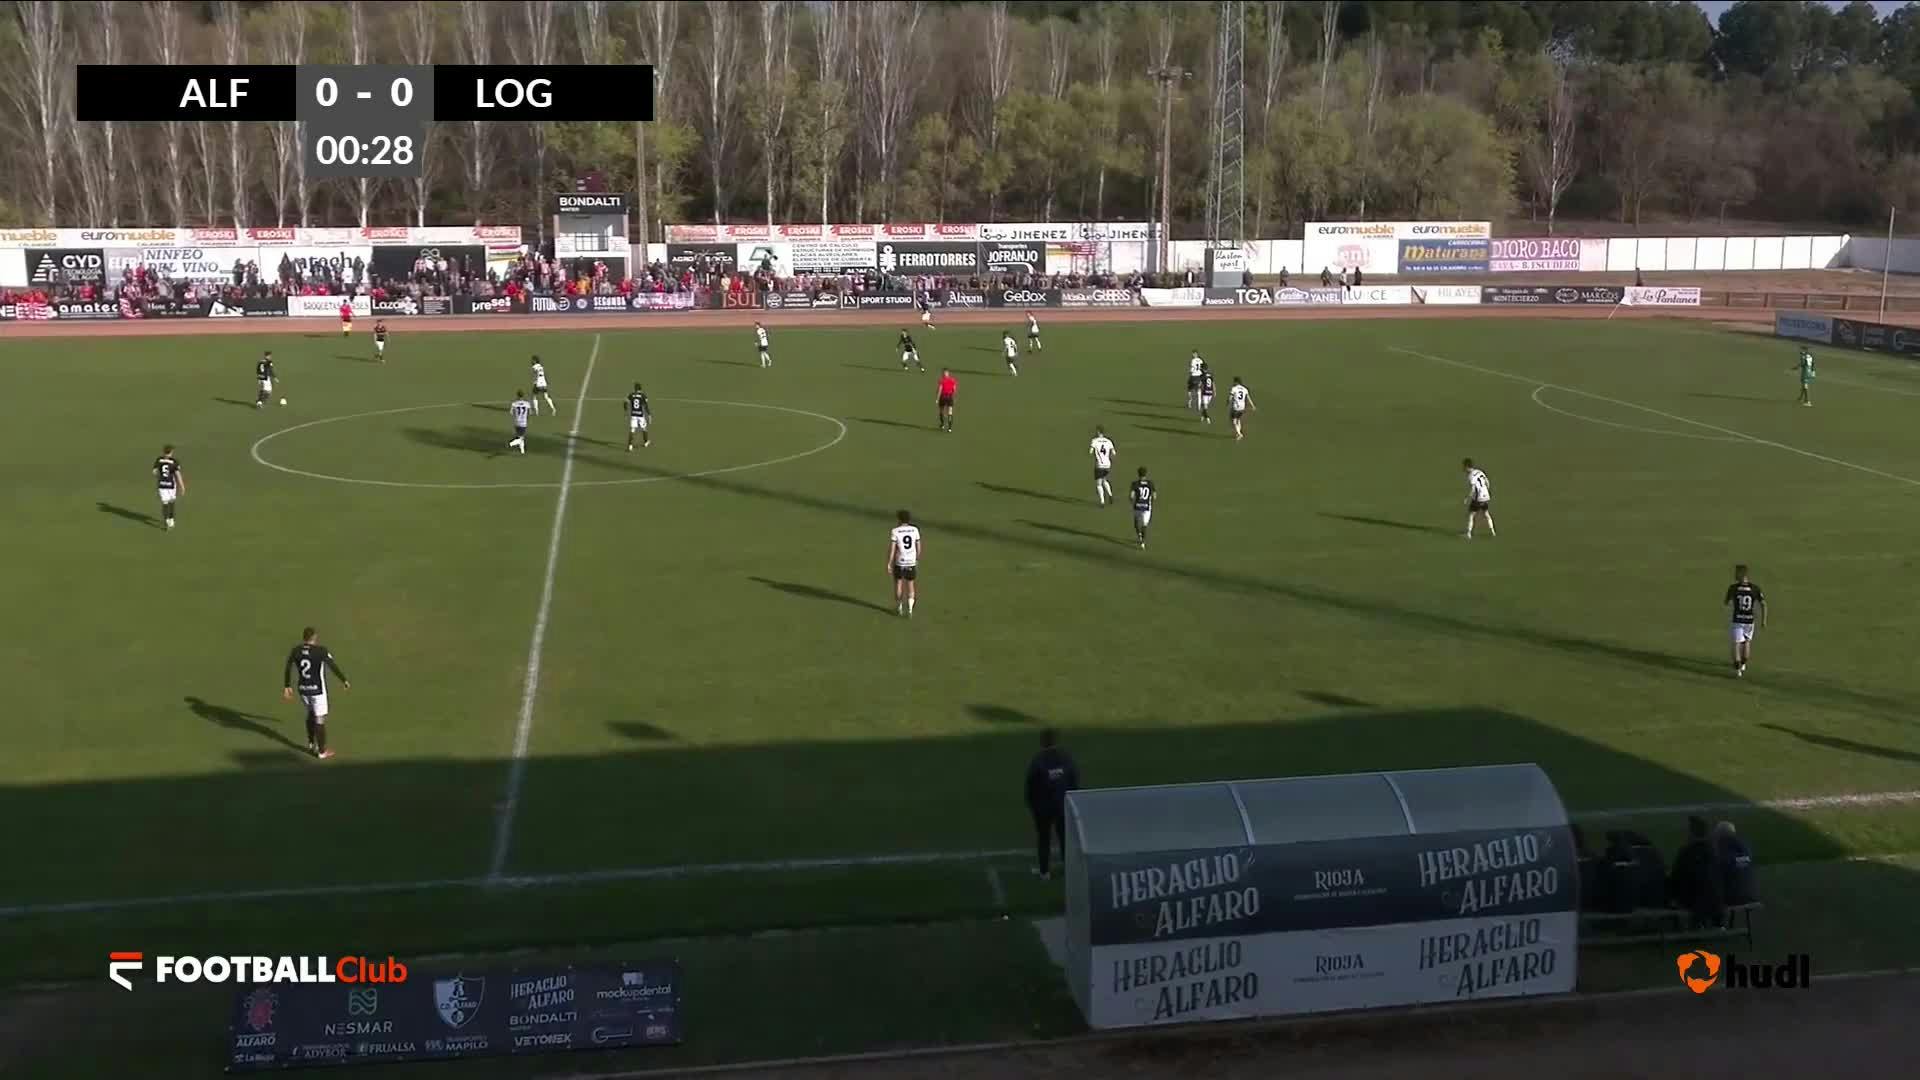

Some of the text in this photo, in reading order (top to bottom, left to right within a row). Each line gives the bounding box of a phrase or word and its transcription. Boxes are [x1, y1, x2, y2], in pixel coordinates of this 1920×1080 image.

[560, 197, 620, 206] BONDALTI
[81, 230, 176, 240] euromueble
[257, 230, 292, 238] EROSKI
[735, 227, 768, 235] EROSKI
[788, 226, 821, 235] EROSKI
[840, 226, 871, 235] EROSKI
[891, 226, 923, 234] EROSKI
[942, 225, 975, 235] EROSKI
[1011, 230, 1067, 239] JIMENEZ
[1318, 224, 1394, 234] euromueble
[1412, 225, 1487, 234] euromueble
[146, 249, 203, 260] NINFEO
[1491, 240, 1579, 258] DIORO BACO
[62, 255, 101, 268] GYD
[900, 254, 976, 266] FERROTORRES
[988, 250, 1038, 262] JOFRANJO
[183, 262, 219, 273] VINO
[861, 296, 884, 304] SPORT
[886, 296, 911, 304] STUDIO
[1003, 290, 1046, 302] GeBox
[1236, 289, 1272, 304] TGA
[1310, 293, 1340, 302] YANEL
[60, 302, 118, 312] amatec
[1238, 391, 1244, 400] 3
[633, 399, 640, 408] 8
[1139, 487, 1150, 500] 10
[902, 535, 912, 550] 9
[1736, 595, 1752, 611] 19
[300, 659, 311, 679] 2
[1417, 834, 1538, 888] HERACLIO
[1111, 853, 1240, 909] HERACLIO
[1459, 866, 1559, 915] ALFARO
[1154, 887, 1260, 937] ALFARO
[1419, 918, 1541, 971] HERACLIO
[1112, 940, 1241, 993] HERACLIO
[1456, 949, 1556, 997] ALFARO
[511, 976, 567, 998] HERACLIO
[528, 989, 574, 1010] ALFARO
[1153, 972, 1259, 1020] ALFARO
[510, 1012, 577, 1026] BONDALTI
[325, 1021, 393, 1036] NESMAR
[236, 1035, 276, 1048] ALFARO
[368, 1042, 416, 1054] FRUALSA
